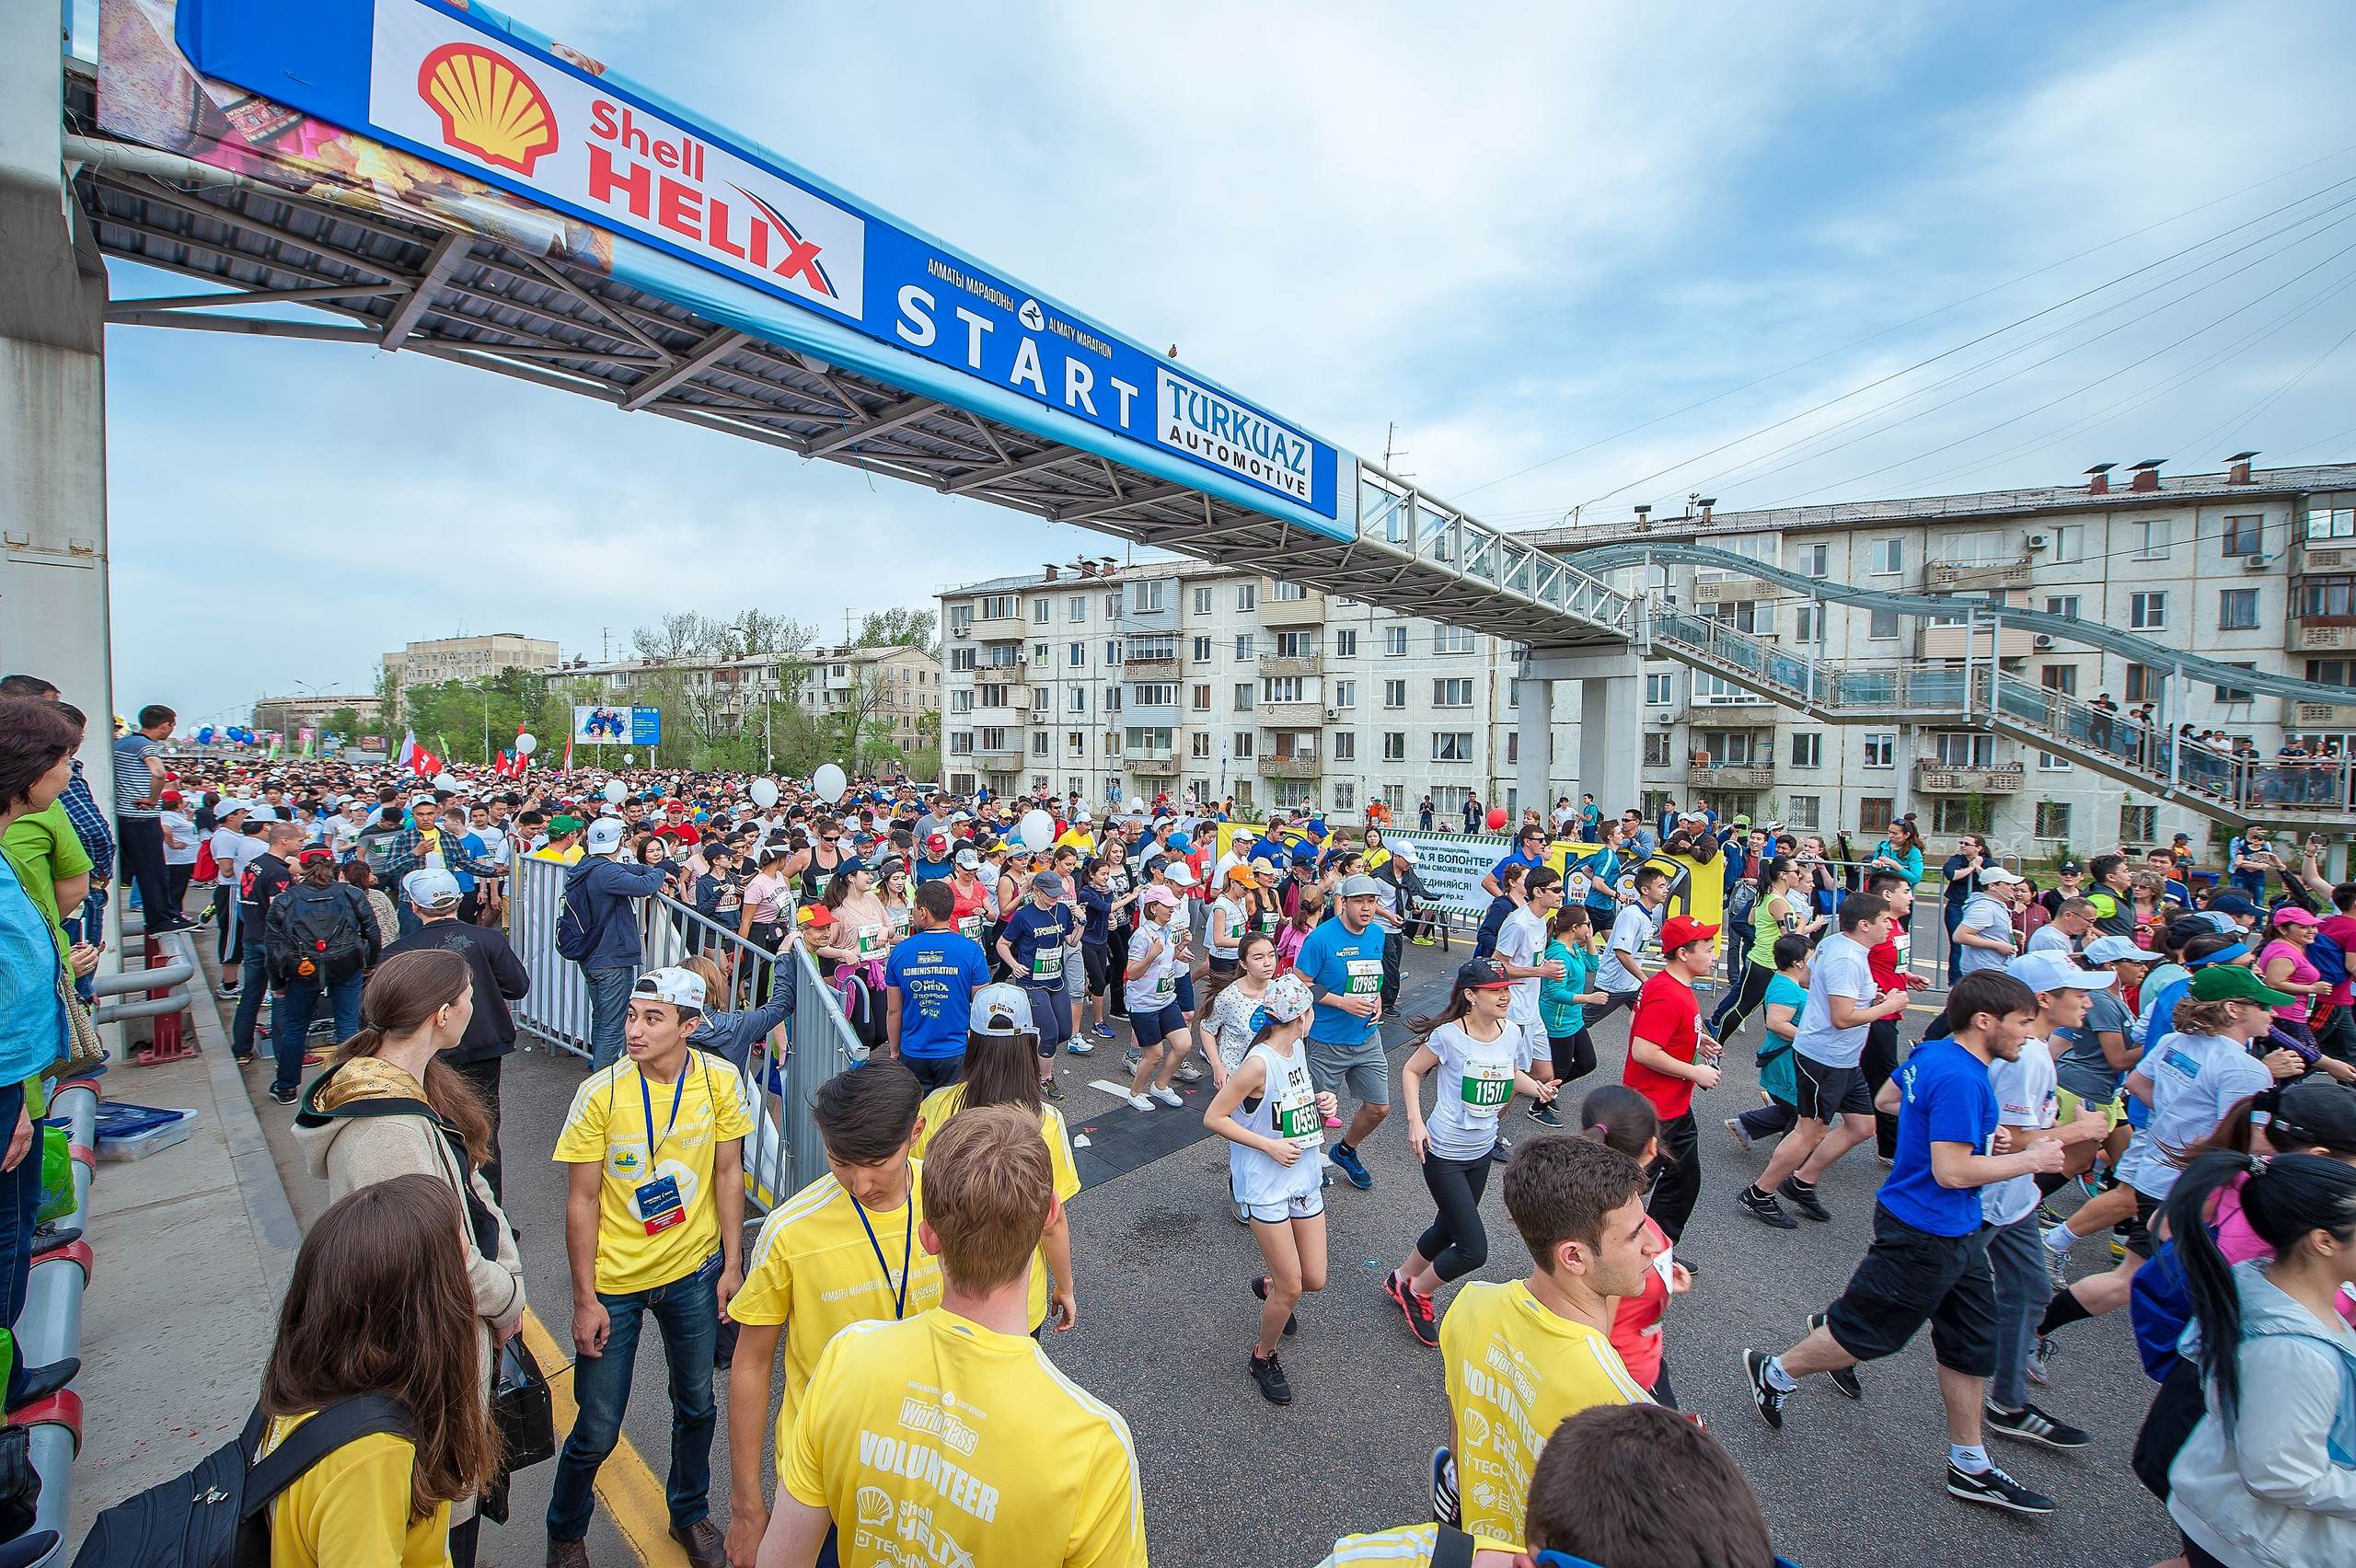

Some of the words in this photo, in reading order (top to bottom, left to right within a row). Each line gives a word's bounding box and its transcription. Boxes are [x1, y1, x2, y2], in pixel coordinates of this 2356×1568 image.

[589, 99, 704, 183] Shell
[584, 140, 830, 297] HELIX
[928, 258, 964, 289] АЛМАТЫ
[966, 275, 1014, 313] МАРАФОНЫ
[896, 284, 1138, 429] START
[1048, 317, 1075, 341] ALMATY
[1076, 329, 1112, 359] MARATHON
[1167, 378, 1305, 476] TURKUAZ
[1169, 424, 1305, 496] AUTOMOTIVE
[1427, 853, 1435, 862] Я
[1438, 854, 1494, 867] ВОЛОНТЕР
[1431, 865, 1462, 873] СМОЖЕМ
[1464, 868, 1479, 876] ВСЕ
[903, 966, 958, 976] ADMINISTRATION
[923, 982, 949, 992] HELIX
[1352, 975, 1379, 993] 07985
[1475, 1080, 1506, 1103] 11511
[821, 1288, 848, 1302] АЛМАТЫ
[1513, 1371, 1534, 1405] Class
[902, 1401, 943, 1433] World
[940, 1417, 976, 1453] Class
[860, 1430, 999, 1524] VOLUNTEER
[899, 1499, 933, 1527] Shell
[896, 1512, 976, 1568] HELIX
